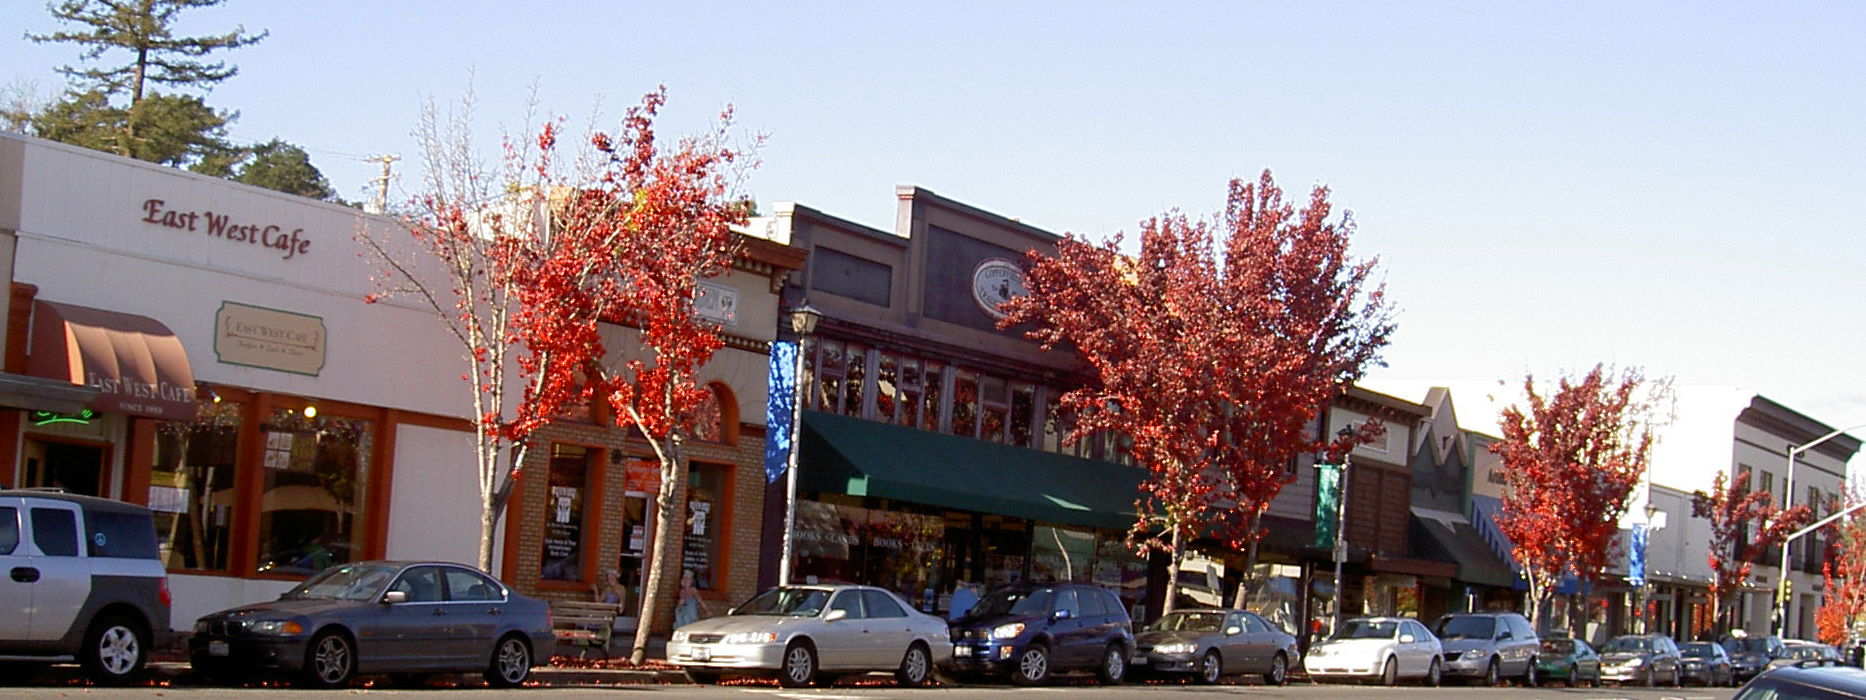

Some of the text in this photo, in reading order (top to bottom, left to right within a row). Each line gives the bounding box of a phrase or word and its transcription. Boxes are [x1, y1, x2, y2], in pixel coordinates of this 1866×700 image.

[143, 199, 310, 259] East West Cafe
[236, 321, 259, 333] EAST
[260, 325, 285, 338] WEST
[89, 372, 191, 403] EAST WEST CAFE
[873, 536, 903, 549] BOOKS
